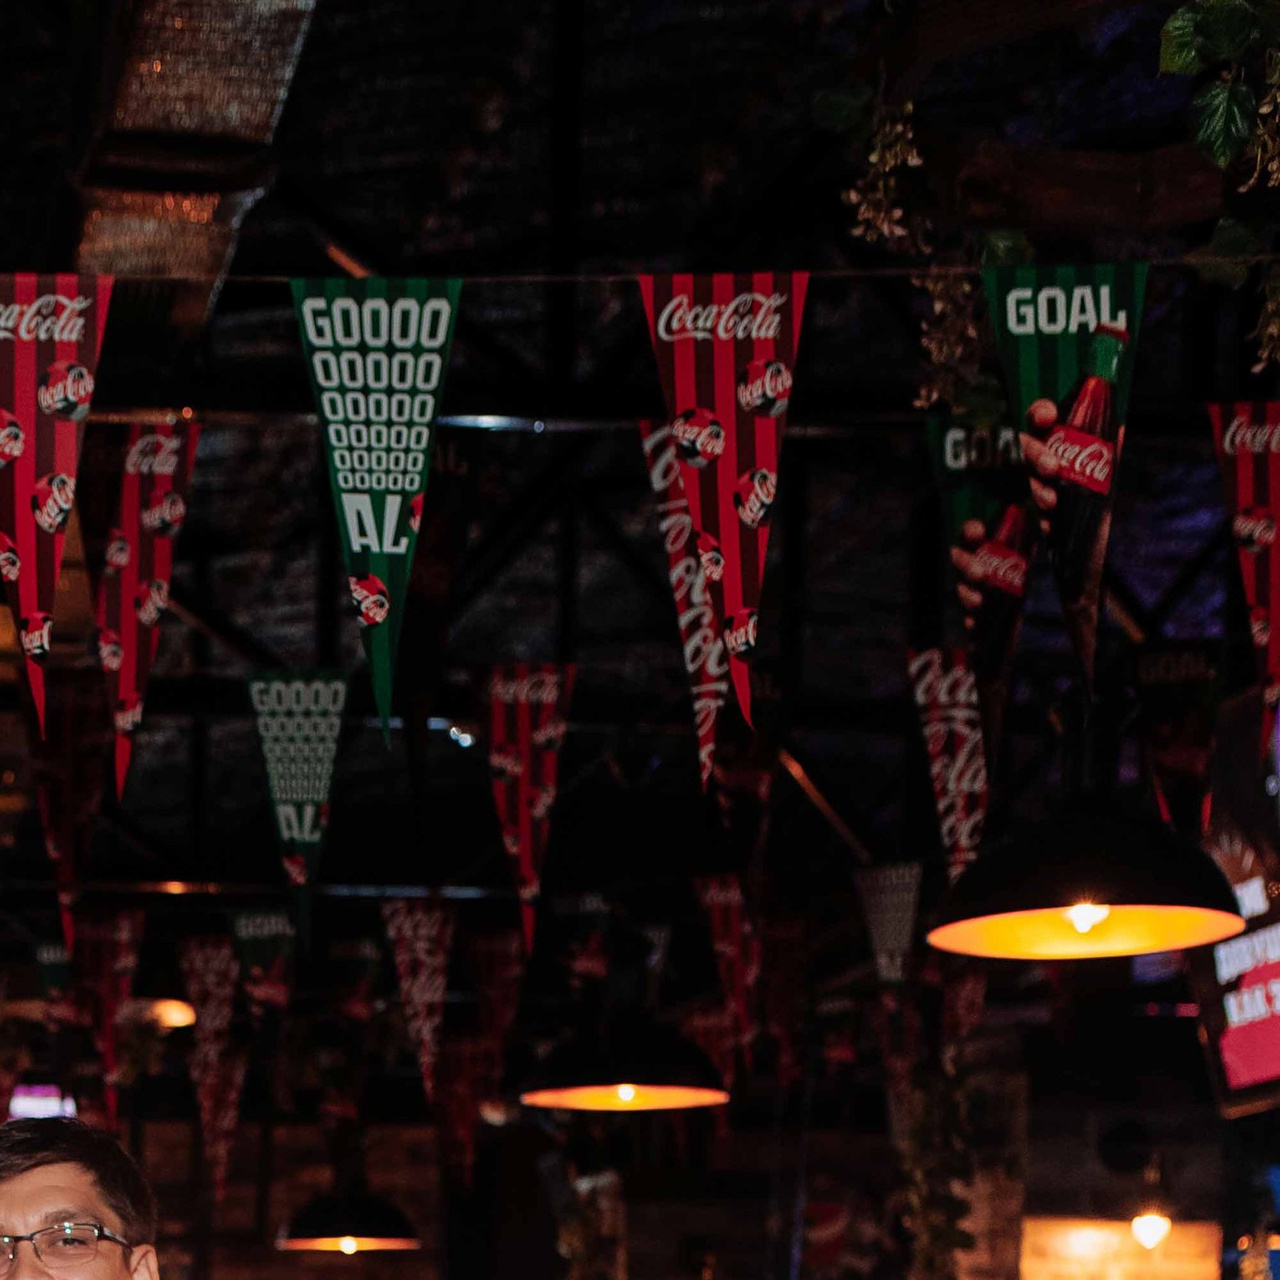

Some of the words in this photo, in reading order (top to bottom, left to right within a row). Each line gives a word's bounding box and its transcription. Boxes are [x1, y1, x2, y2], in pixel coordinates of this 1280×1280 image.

[301, 296, 451, 349] GOOOO
[657, 291, 788, 342] Coca-Cola
[1005, 284, 1127, 335] GOAL
[312, 350, 442, 391] OOOOO
[321, 390, 435, 424] OOOOO
[327, 423, 430, 450] OOOOO
[341, 492, 409, 555] AL
